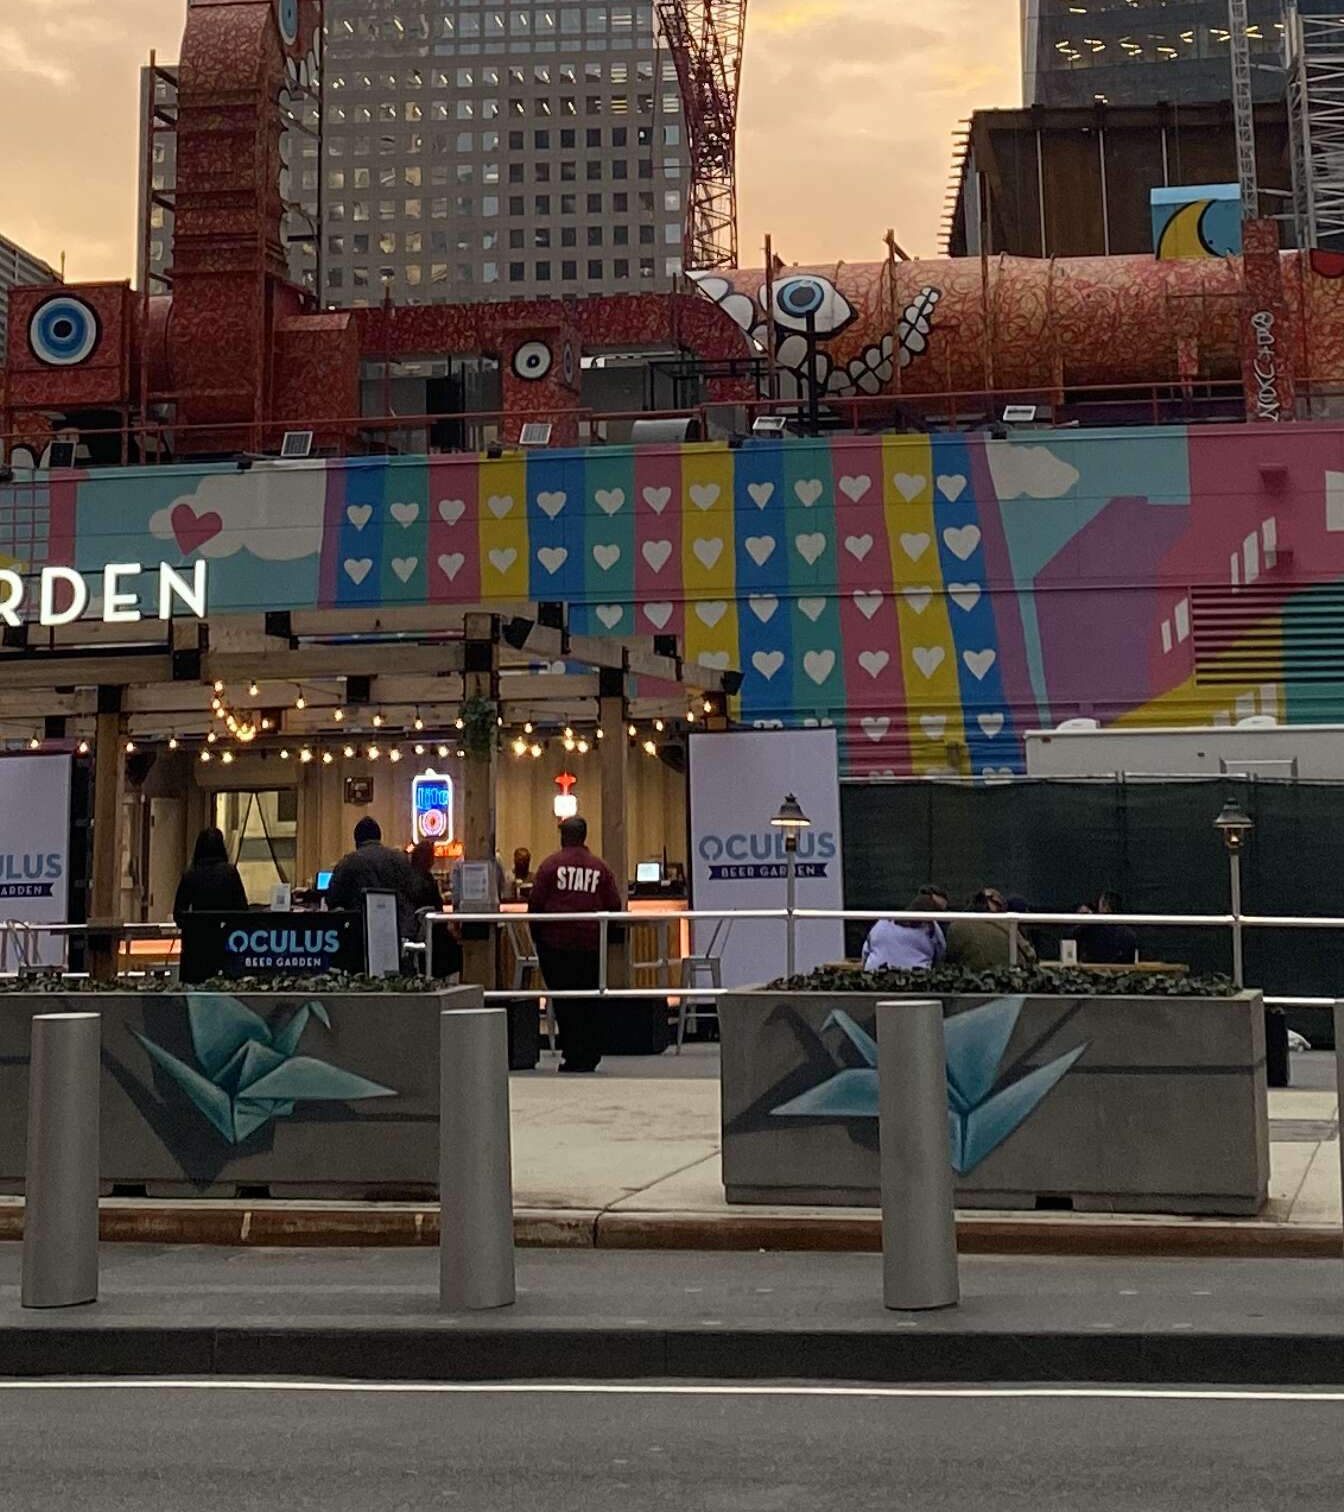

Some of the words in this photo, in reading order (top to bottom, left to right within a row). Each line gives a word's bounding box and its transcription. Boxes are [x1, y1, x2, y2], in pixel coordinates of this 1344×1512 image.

[557, 866, 601, 893] STAFF
[721, 868, 755, 878] BEER
[759, 865, 816, 878] GAREN
[228, 930, 340, 953] OCULUS
[245, 957, 273, 967] BEER
[276, 957, 321, 967] GARDEN
